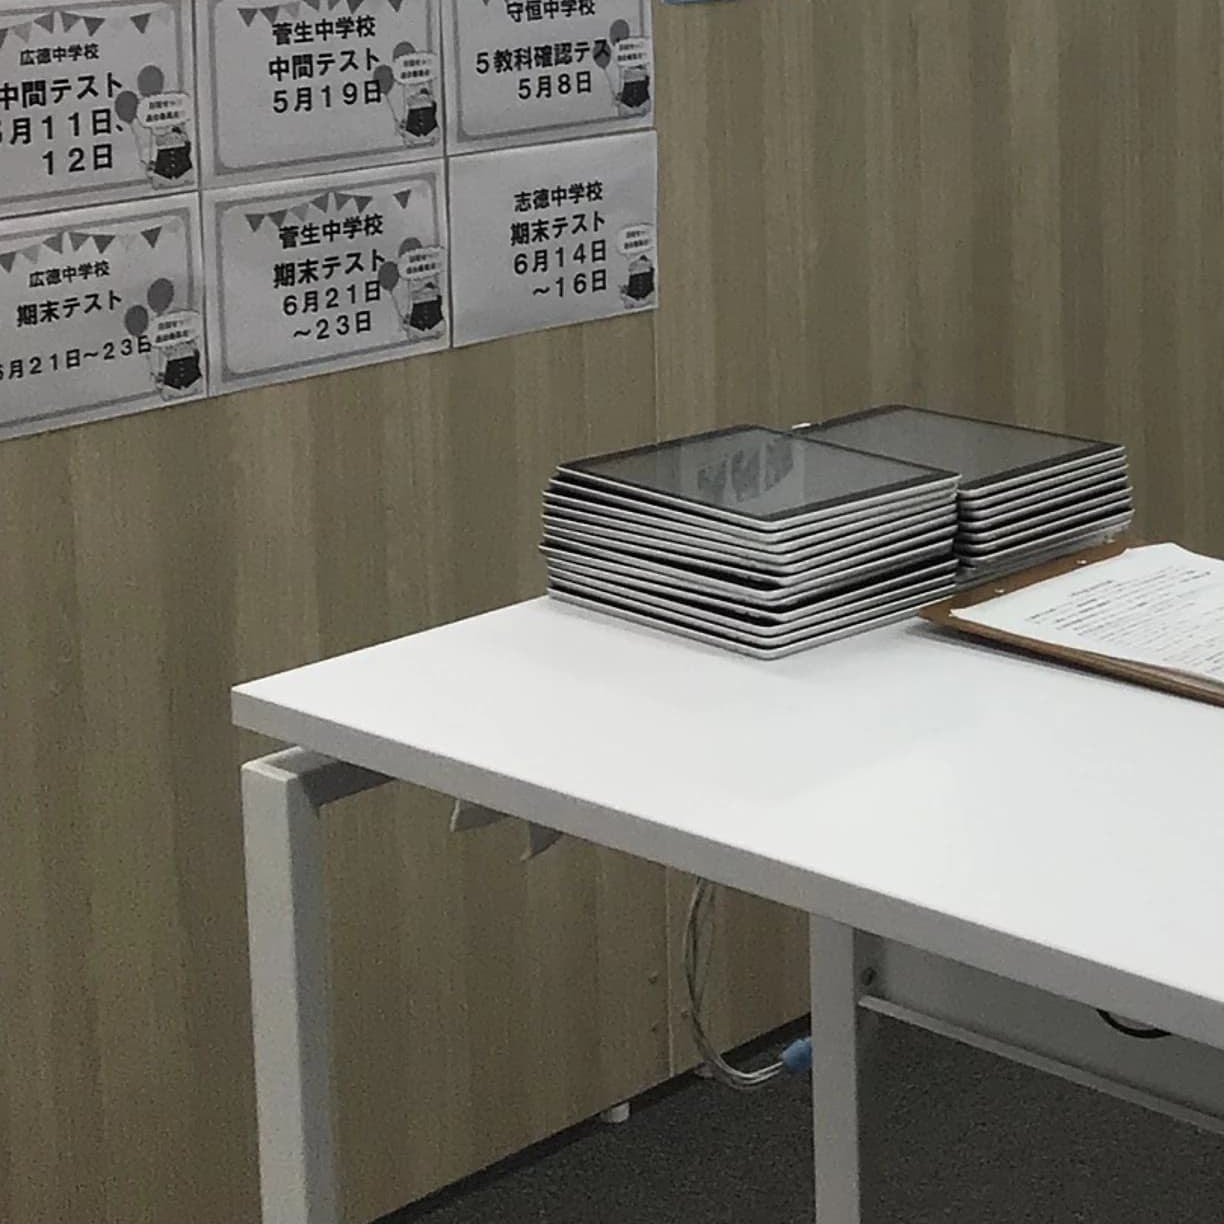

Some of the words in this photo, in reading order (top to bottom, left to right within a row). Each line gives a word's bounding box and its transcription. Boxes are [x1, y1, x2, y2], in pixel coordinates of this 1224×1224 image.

[271, 15, 376, 46] 菅生中学校
[268, 47, 381, 82] 中間テスト
[476, 38, 613, 75] 5教科確認テス
[0, 71, 123, 110] 中間テスト
[272, 79, 382, 114] 5月19日
[518, 71, 592, 100] 5月8日
[42, 143, 113, 176] 12日
[513, 180, 604, 213] 志徳中学校
[278, 213, 384, 250] 菅生中学校
[510, 211, 606, 248] 期末テスト
[272, 248, 386, 290] 期末テスト
[513, 239, 607, 276] 6月14日
[16, 289, 122, 328] 期末テスト
[283, 279, 382, 316] 6月21日
